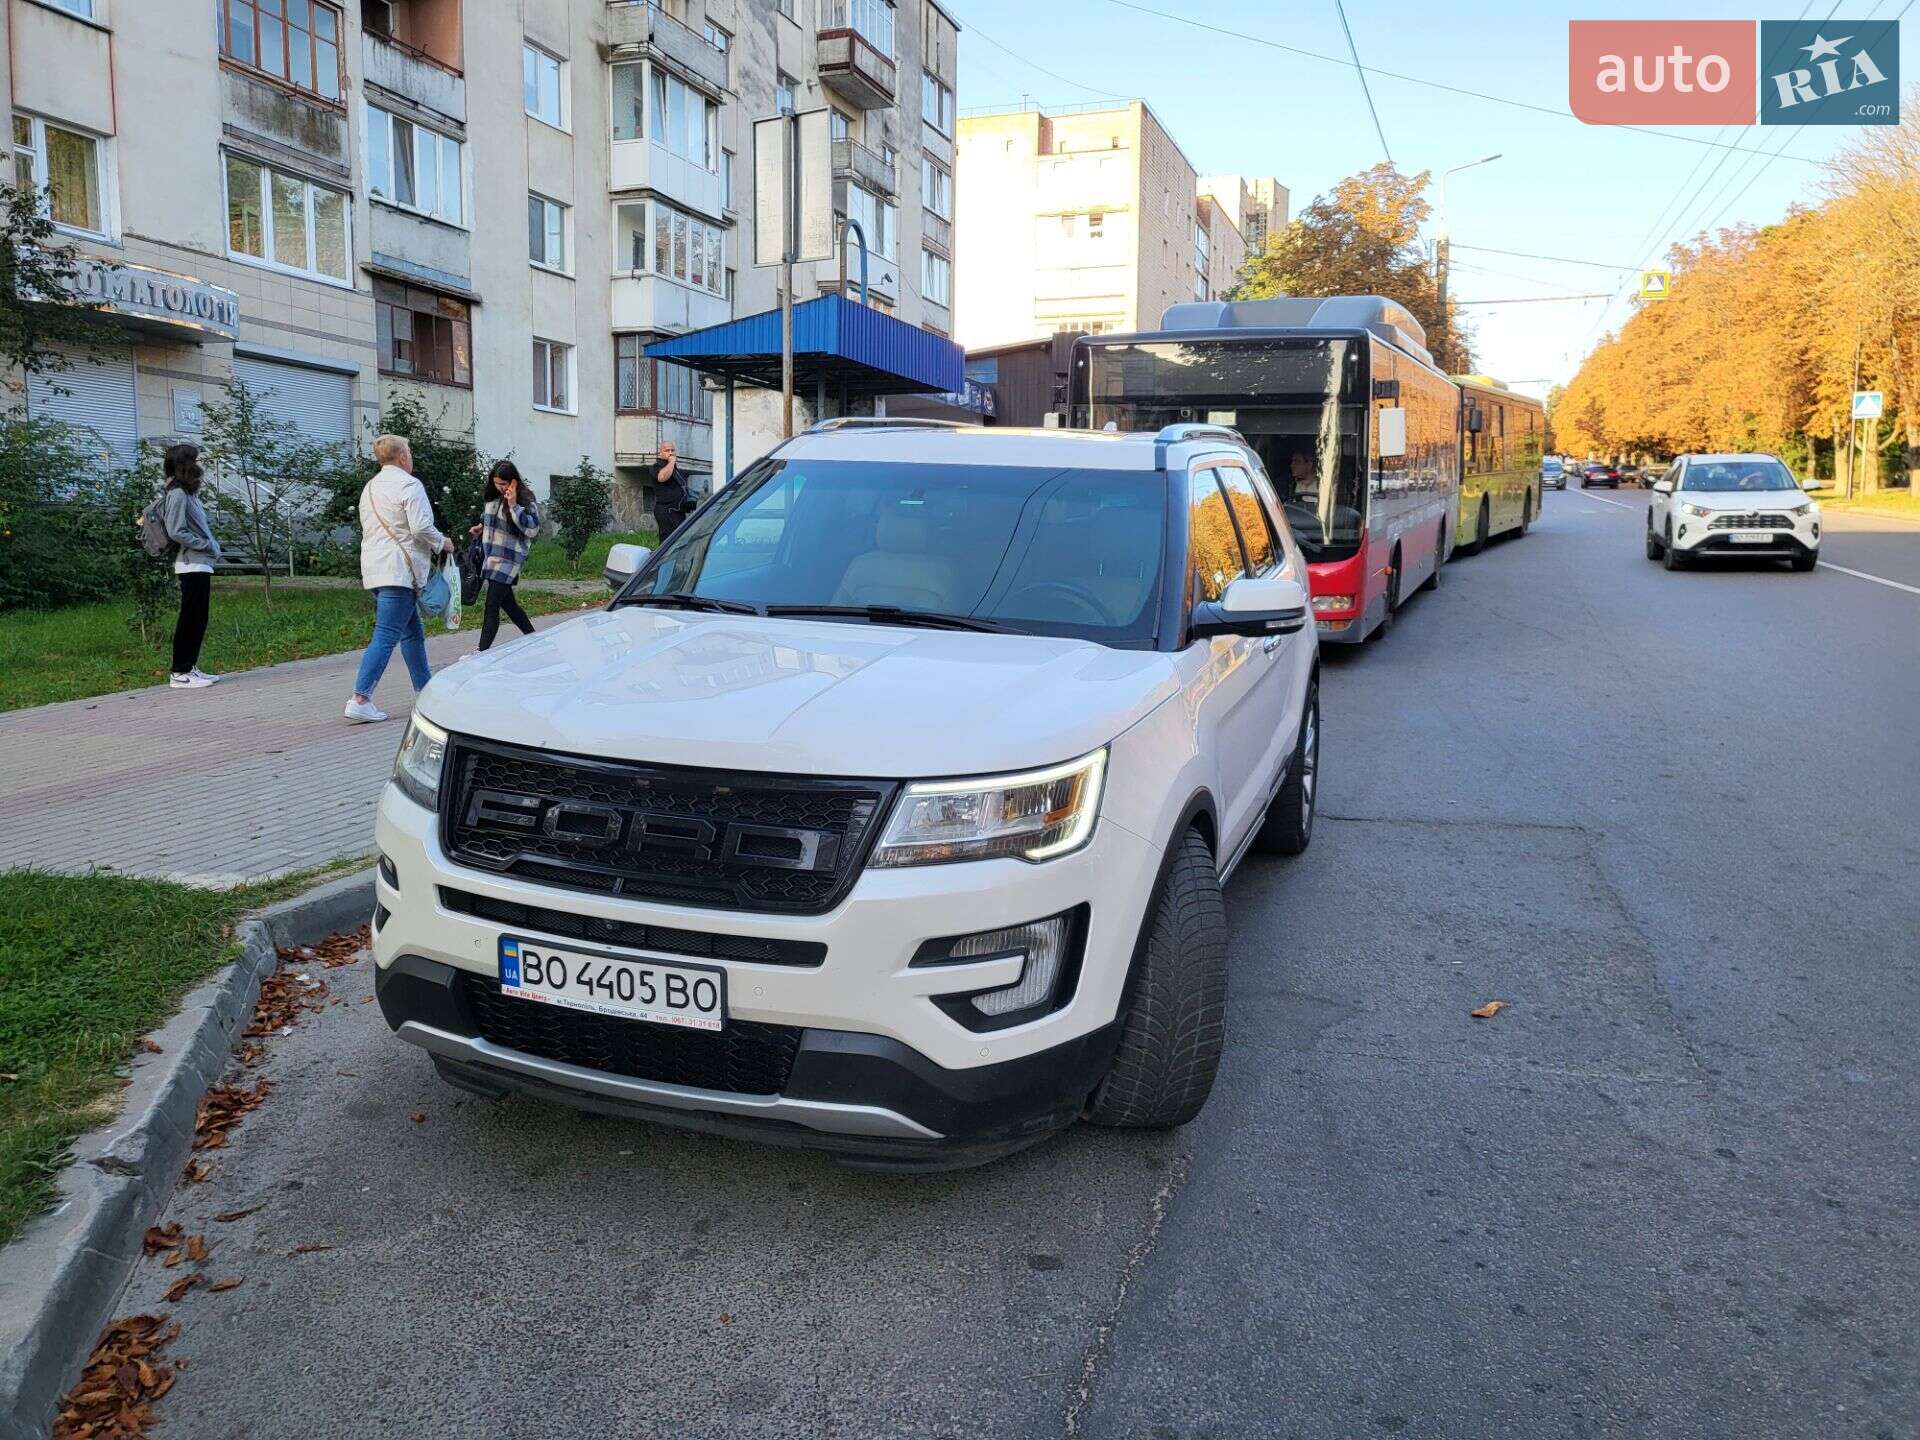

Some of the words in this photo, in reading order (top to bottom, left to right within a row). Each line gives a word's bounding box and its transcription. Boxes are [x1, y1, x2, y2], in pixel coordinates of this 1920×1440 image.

[50, 263, 239, 327] ОМАТОЛОГІЯ
[465, 789, 844, 873] FORD
[505, 968, 519, 980] UA
[521, 949, 568, 990] BO
[576, 961, 657, 1004] 4405
[665, 973, 718, 1012] BO
